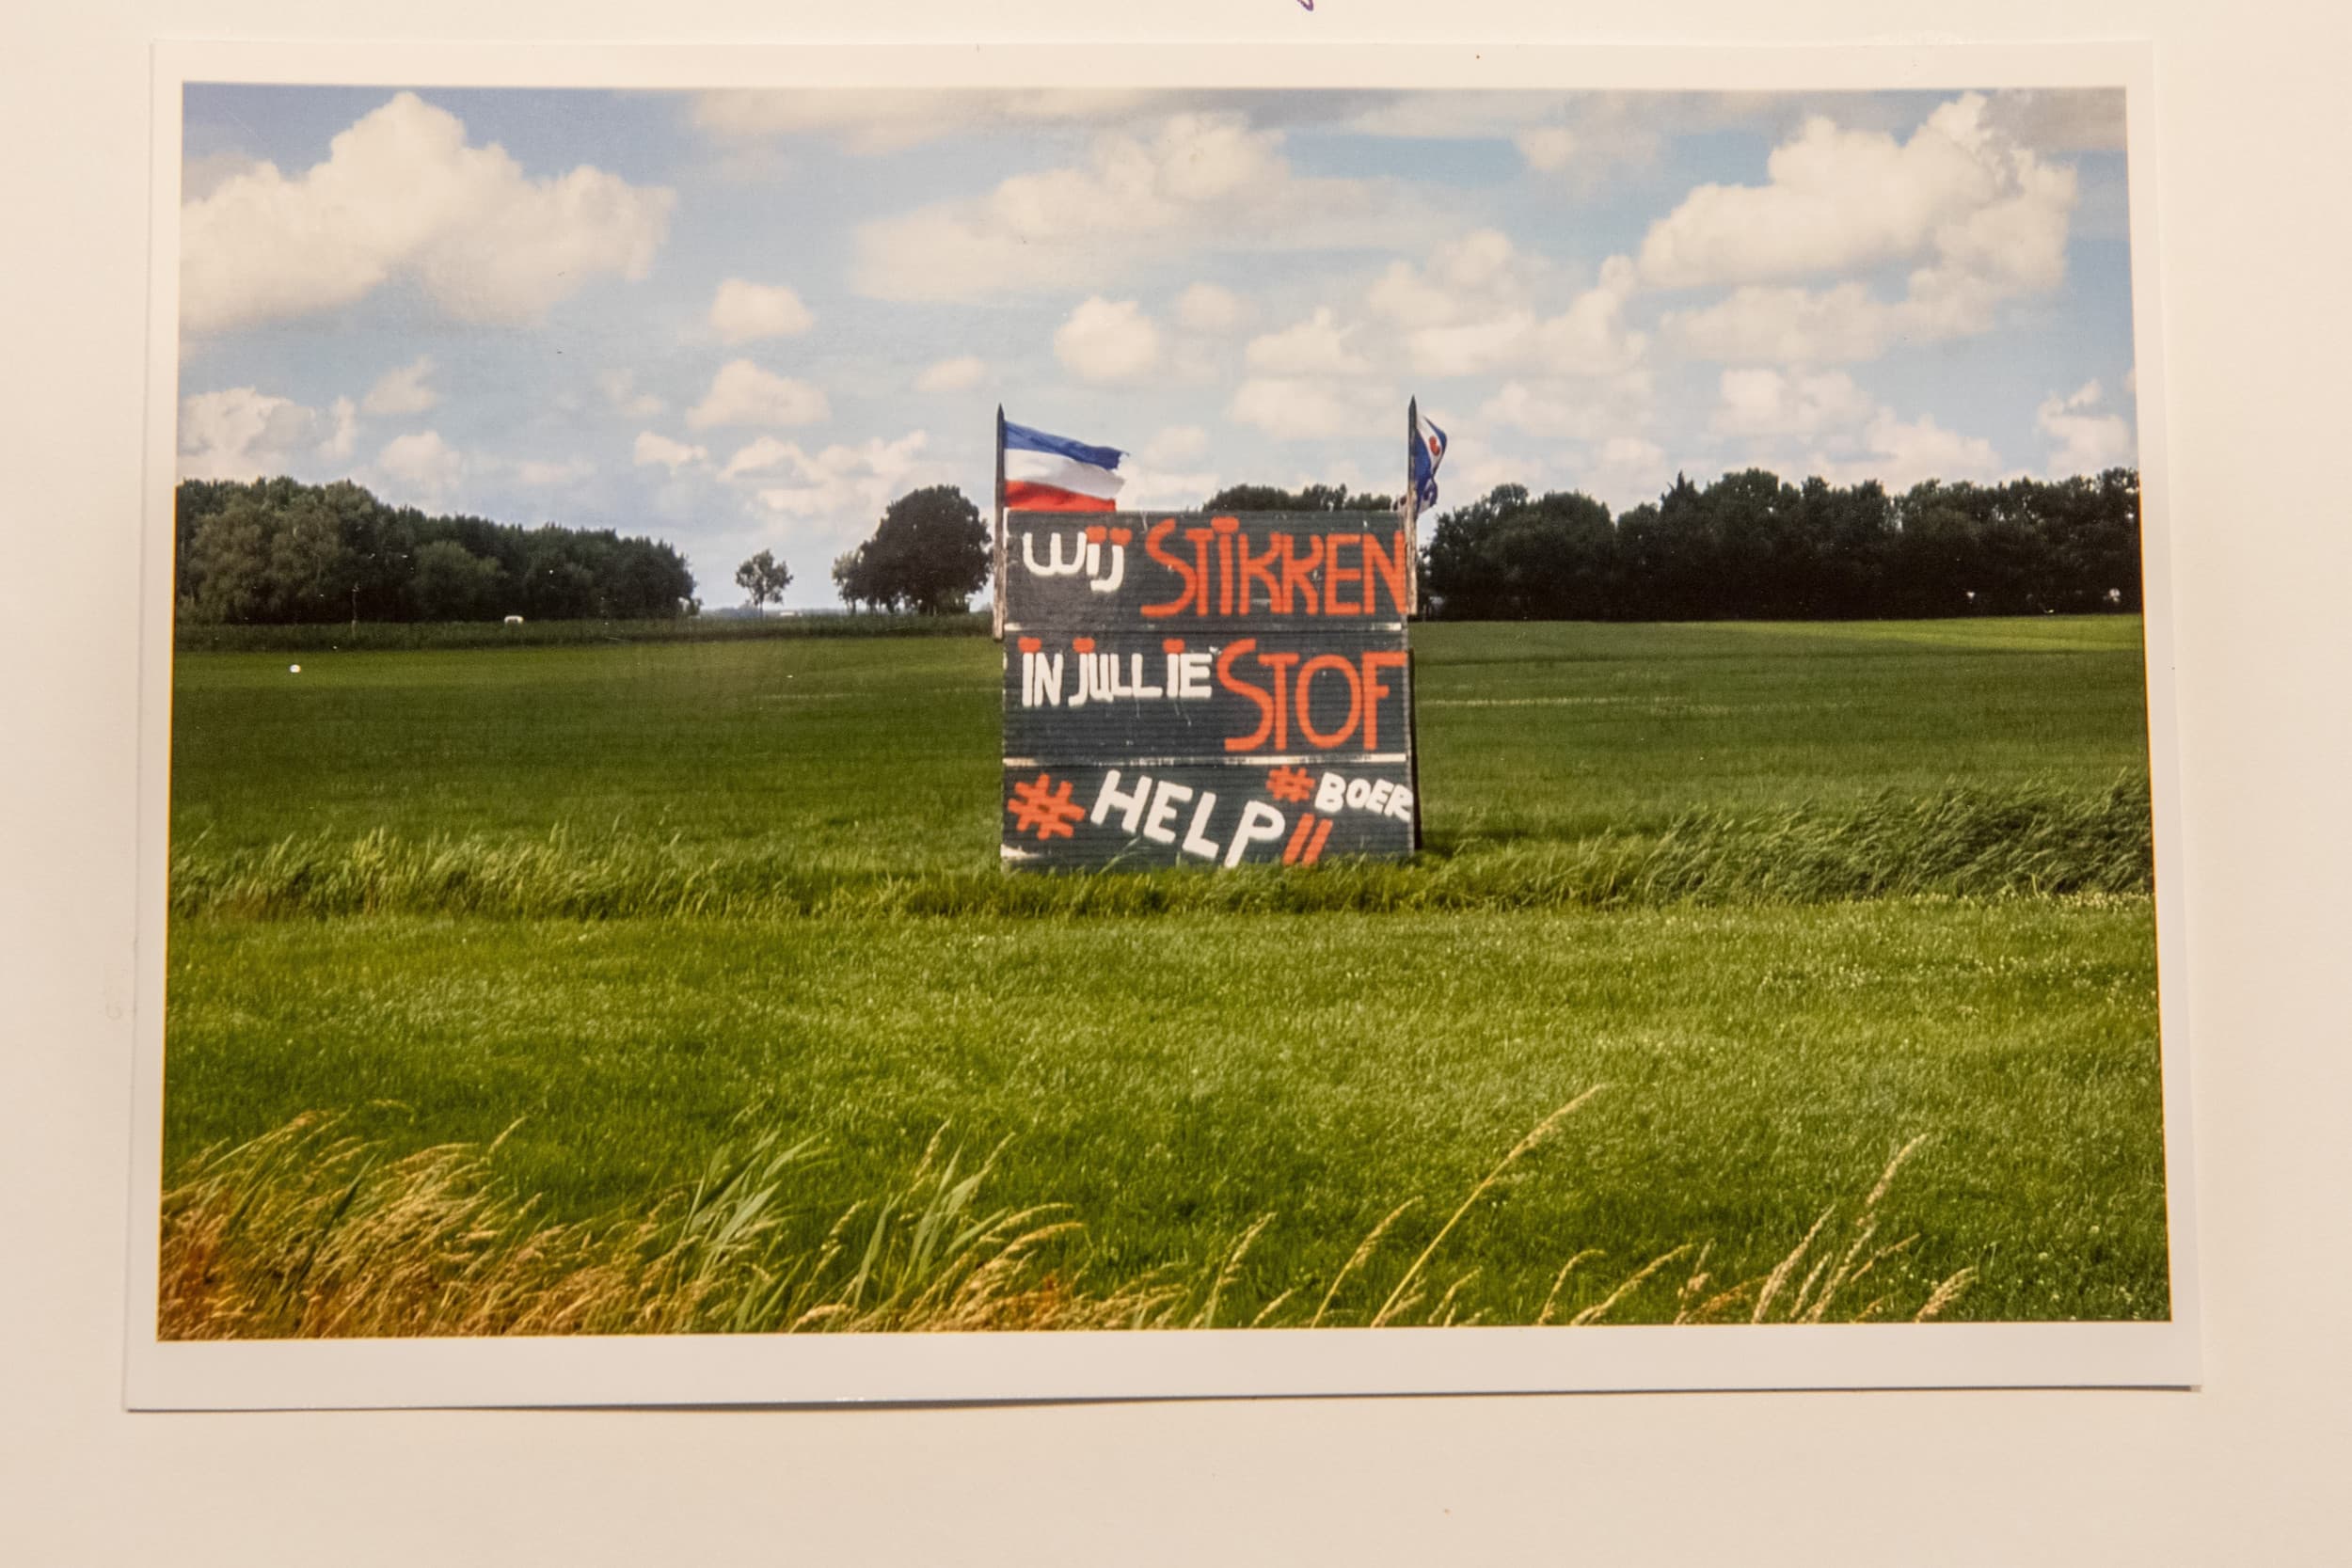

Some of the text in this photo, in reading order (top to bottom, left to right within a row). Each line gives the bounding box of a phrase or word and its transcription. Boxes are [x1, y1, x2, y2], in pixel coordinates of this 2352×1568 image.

[1140, 517, 1408, 617] STIKKEN
[1018, 637, 1407, 751] IN JULLIE STOF
